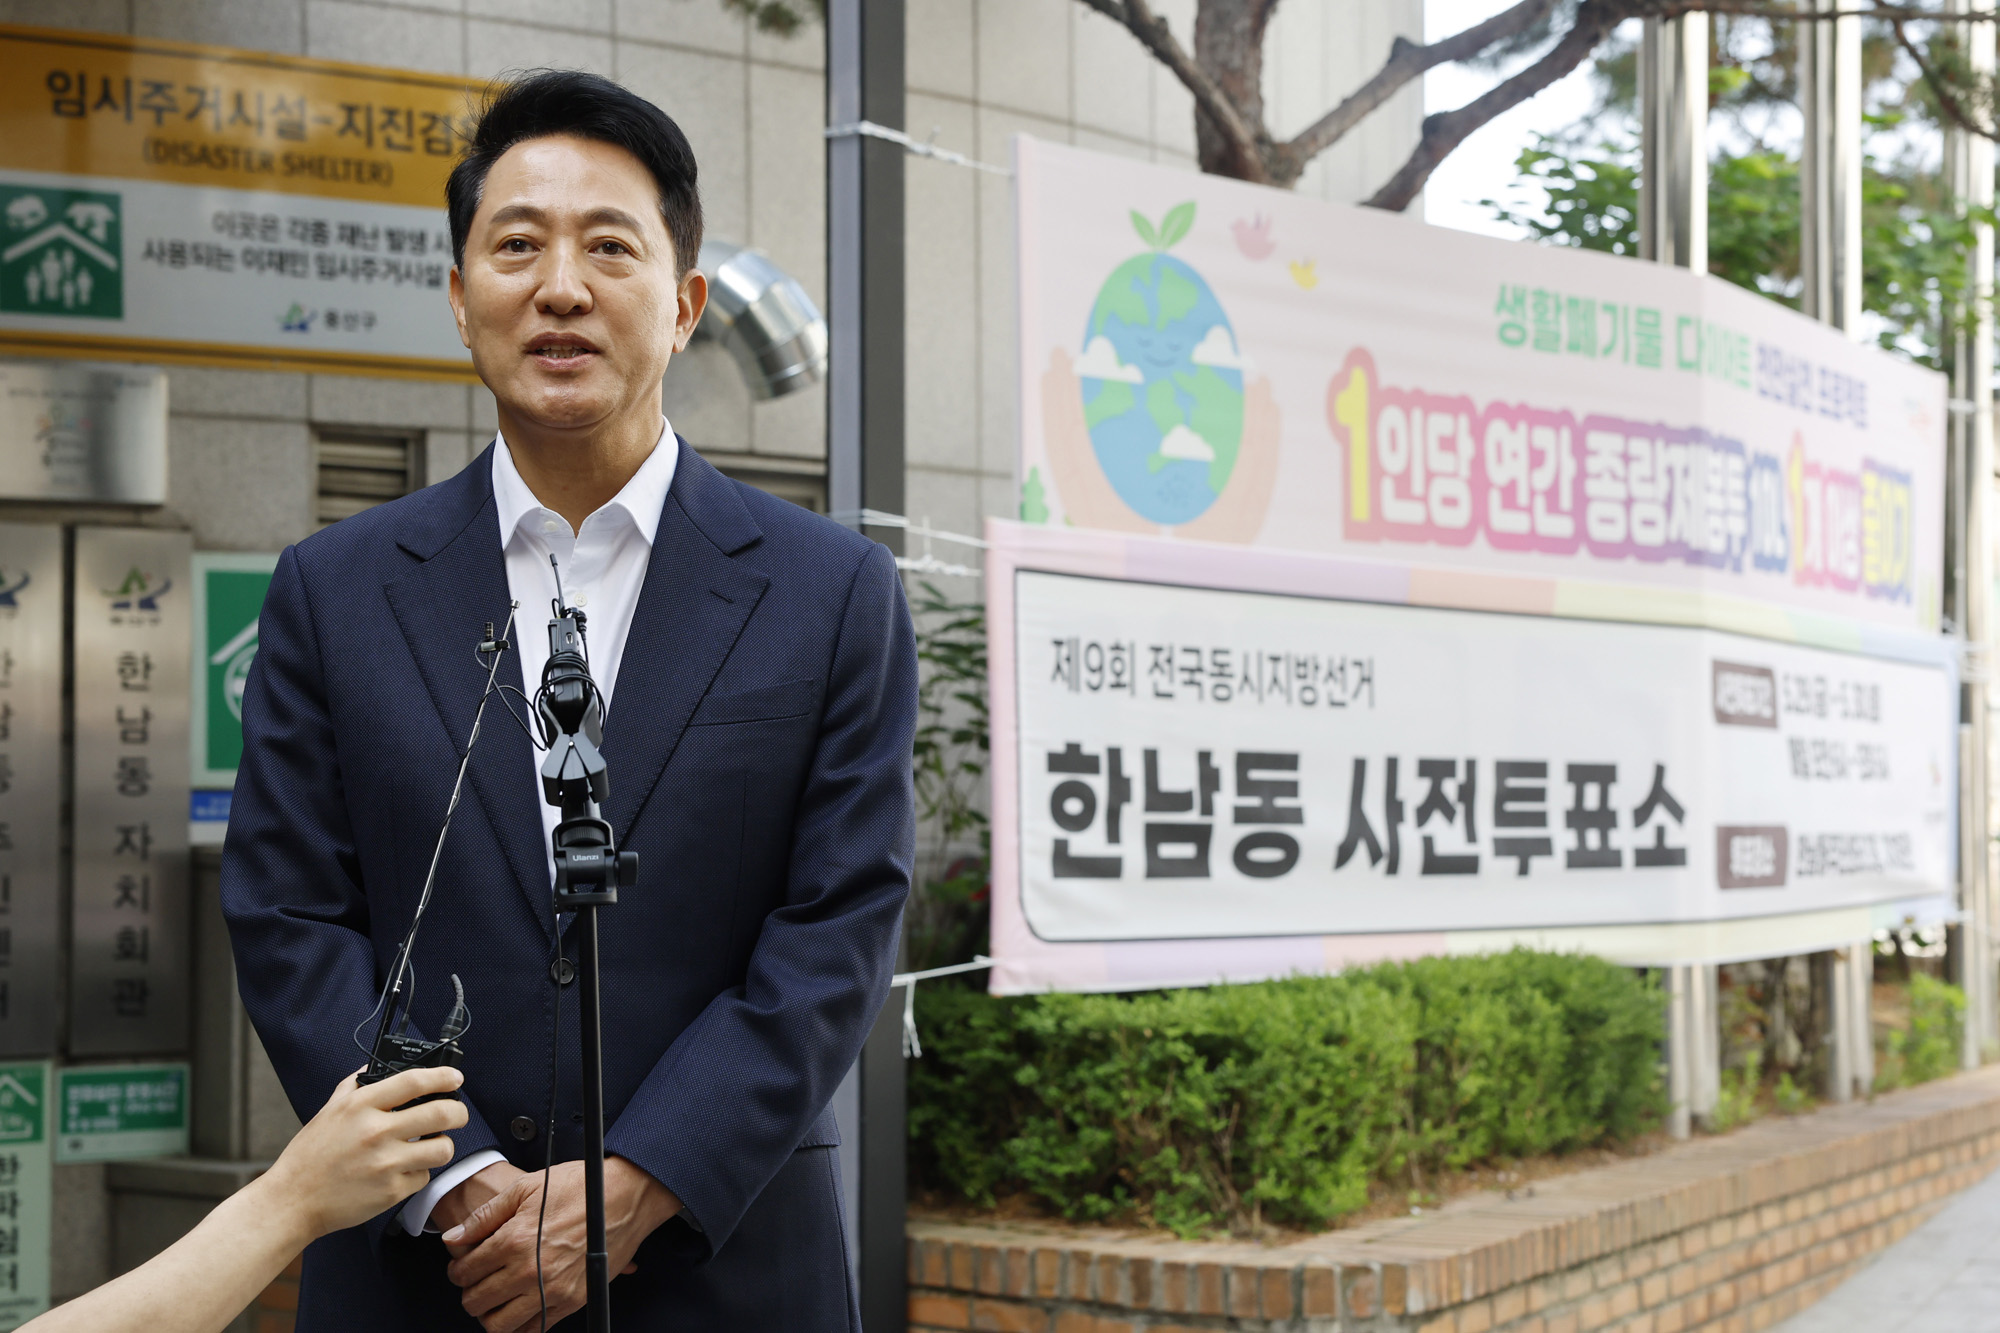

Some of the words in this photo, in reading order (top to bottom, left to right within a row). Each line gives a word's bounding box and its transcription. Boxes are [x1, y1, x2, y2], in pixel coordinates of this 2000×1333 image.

[144, 137, 274, 176] (DISASTER
[282, 150, 393, 188] SHELTER)
[143, 238, 234, 272] 사용되는
[315, 254, 443, 289] 임시주거시설
[212, 211, 279, 243] 이곳은
[1495, 282, 1662, 369] 생활폐기물
[1332, 362, 1477, 532] 1인당
[1484, 416, 1577, 540] 연간
[1050, 636, 1136, 697] 제9회
[1147, 643, 1375, 708] 전국동시지방선거
[115, 652, 154, 797] 한남동
[1046, 742, 1305, 879] 한남동
[1333, 755, 1688, 877] 사전투표소
[572, 854, 599, 862] Ulanzi
[113, 822, 152, 1018] 자치회관
